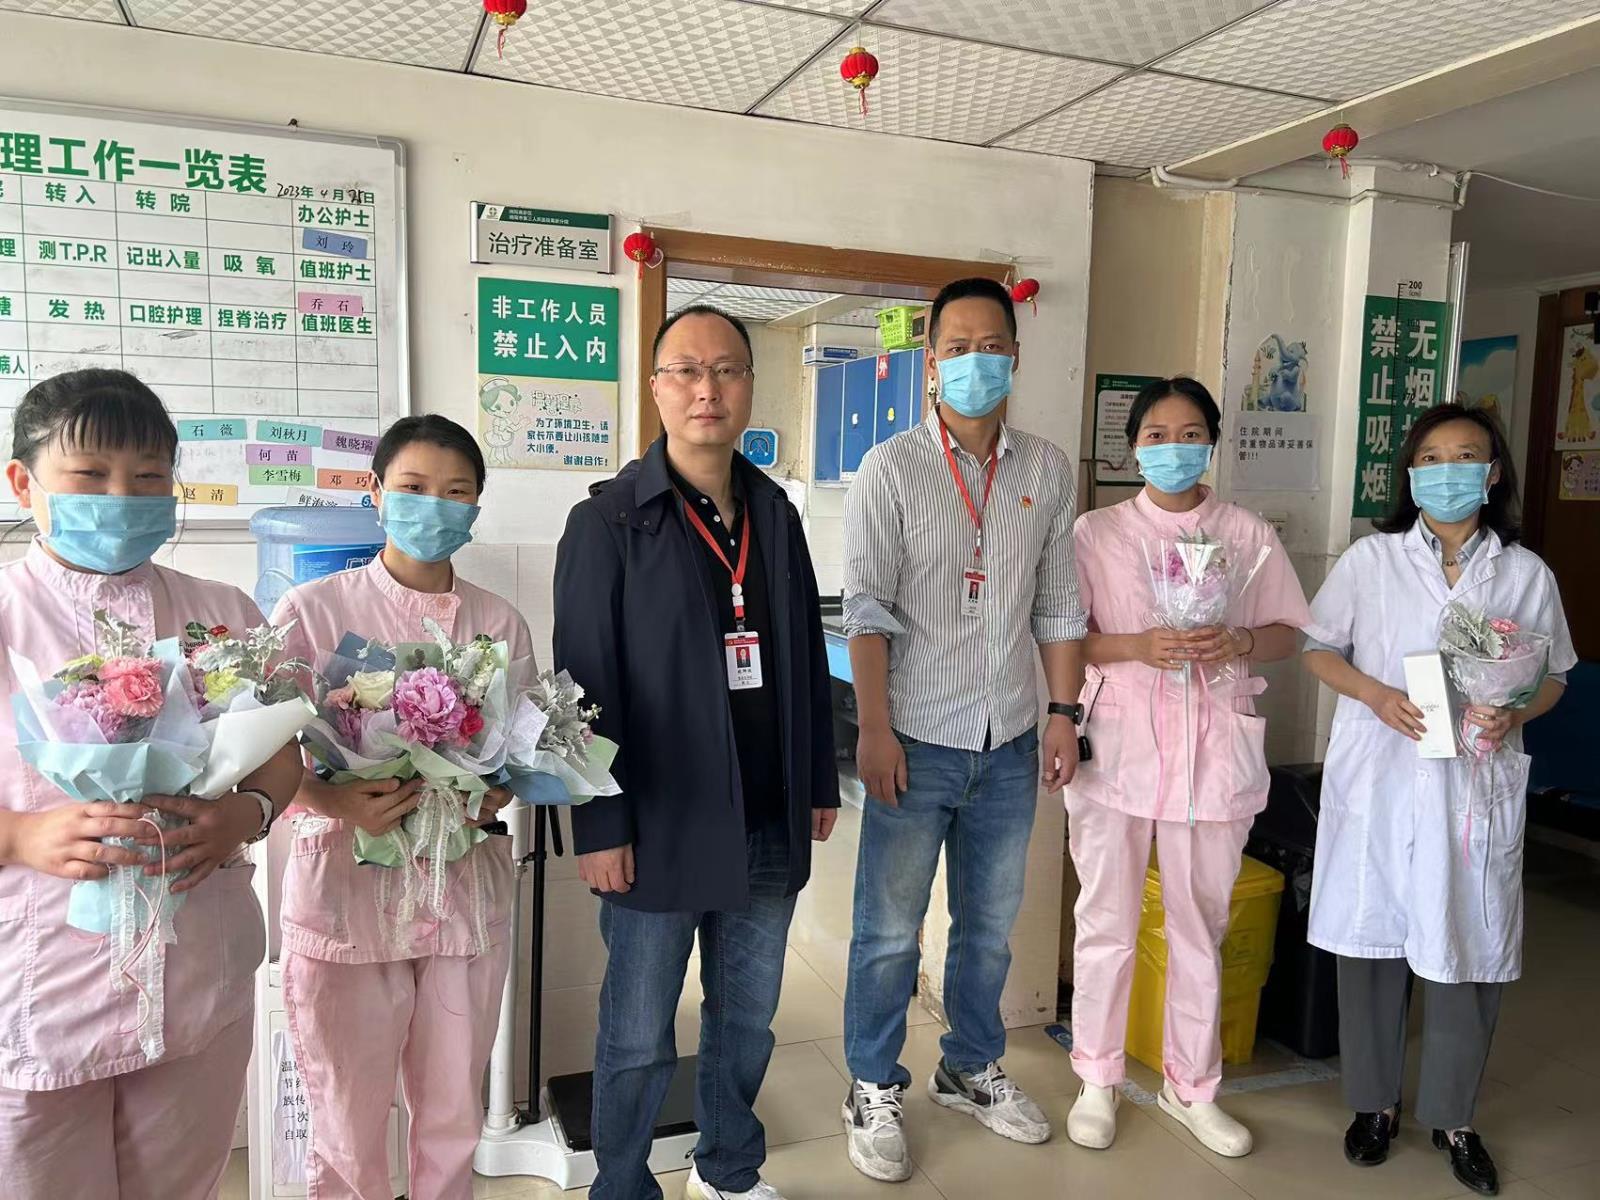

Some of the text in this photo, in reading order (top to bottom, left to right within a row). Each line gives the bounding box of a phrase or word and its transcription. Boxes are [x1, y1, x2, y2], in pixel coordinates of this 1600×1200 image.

[0, 132, 267, 194] 理工作一览表
[45, 182, 96, 205] 转入
[136, 190, 190, 213] 转院
[298, 205, 370, 228] 办公护士
[315, 234, 355, 254] 刘玲
[488, 232, 599, 261] 治疗准备室
[127, 246, 201, 270] 记出入量
[223, 254, 276, 275] 吸氧
[299, 259, 372, 282] 值班护士
[1408, 280, 1423, 290] 200
[48, 298, 106, 321] 发热
[130, 303, 203, 327] 口腔护理
[310, 298, 350, 313] 乔石
[492, 295, 607, 326] 非工作人员
[218, 307, 288, 330] 捏脊治疗
[301, 315, 373, 335] 值班医生
[492, 330, 607, 364] 禁止入内
[1360, 314, 1401, 504] 禁止吸烟
[191, 423, 234, 437] 石薇
[270, 426, 308, 441] 刘秋月
[1239, 426, 1283, 437] 住院期间
[335, 435, 374, 453] 魏晓瑞
[1239, 439, 1313, 449] 贵重物品请妥善保
[258, 448, 300, 462] 何苗
[263, 469, 302, 483] 李雪梅
[184, 487, 225, 502] 赵清
[283, 1110, 310, 1123] 一次
[284, 1128, 308, 1141] 自取
